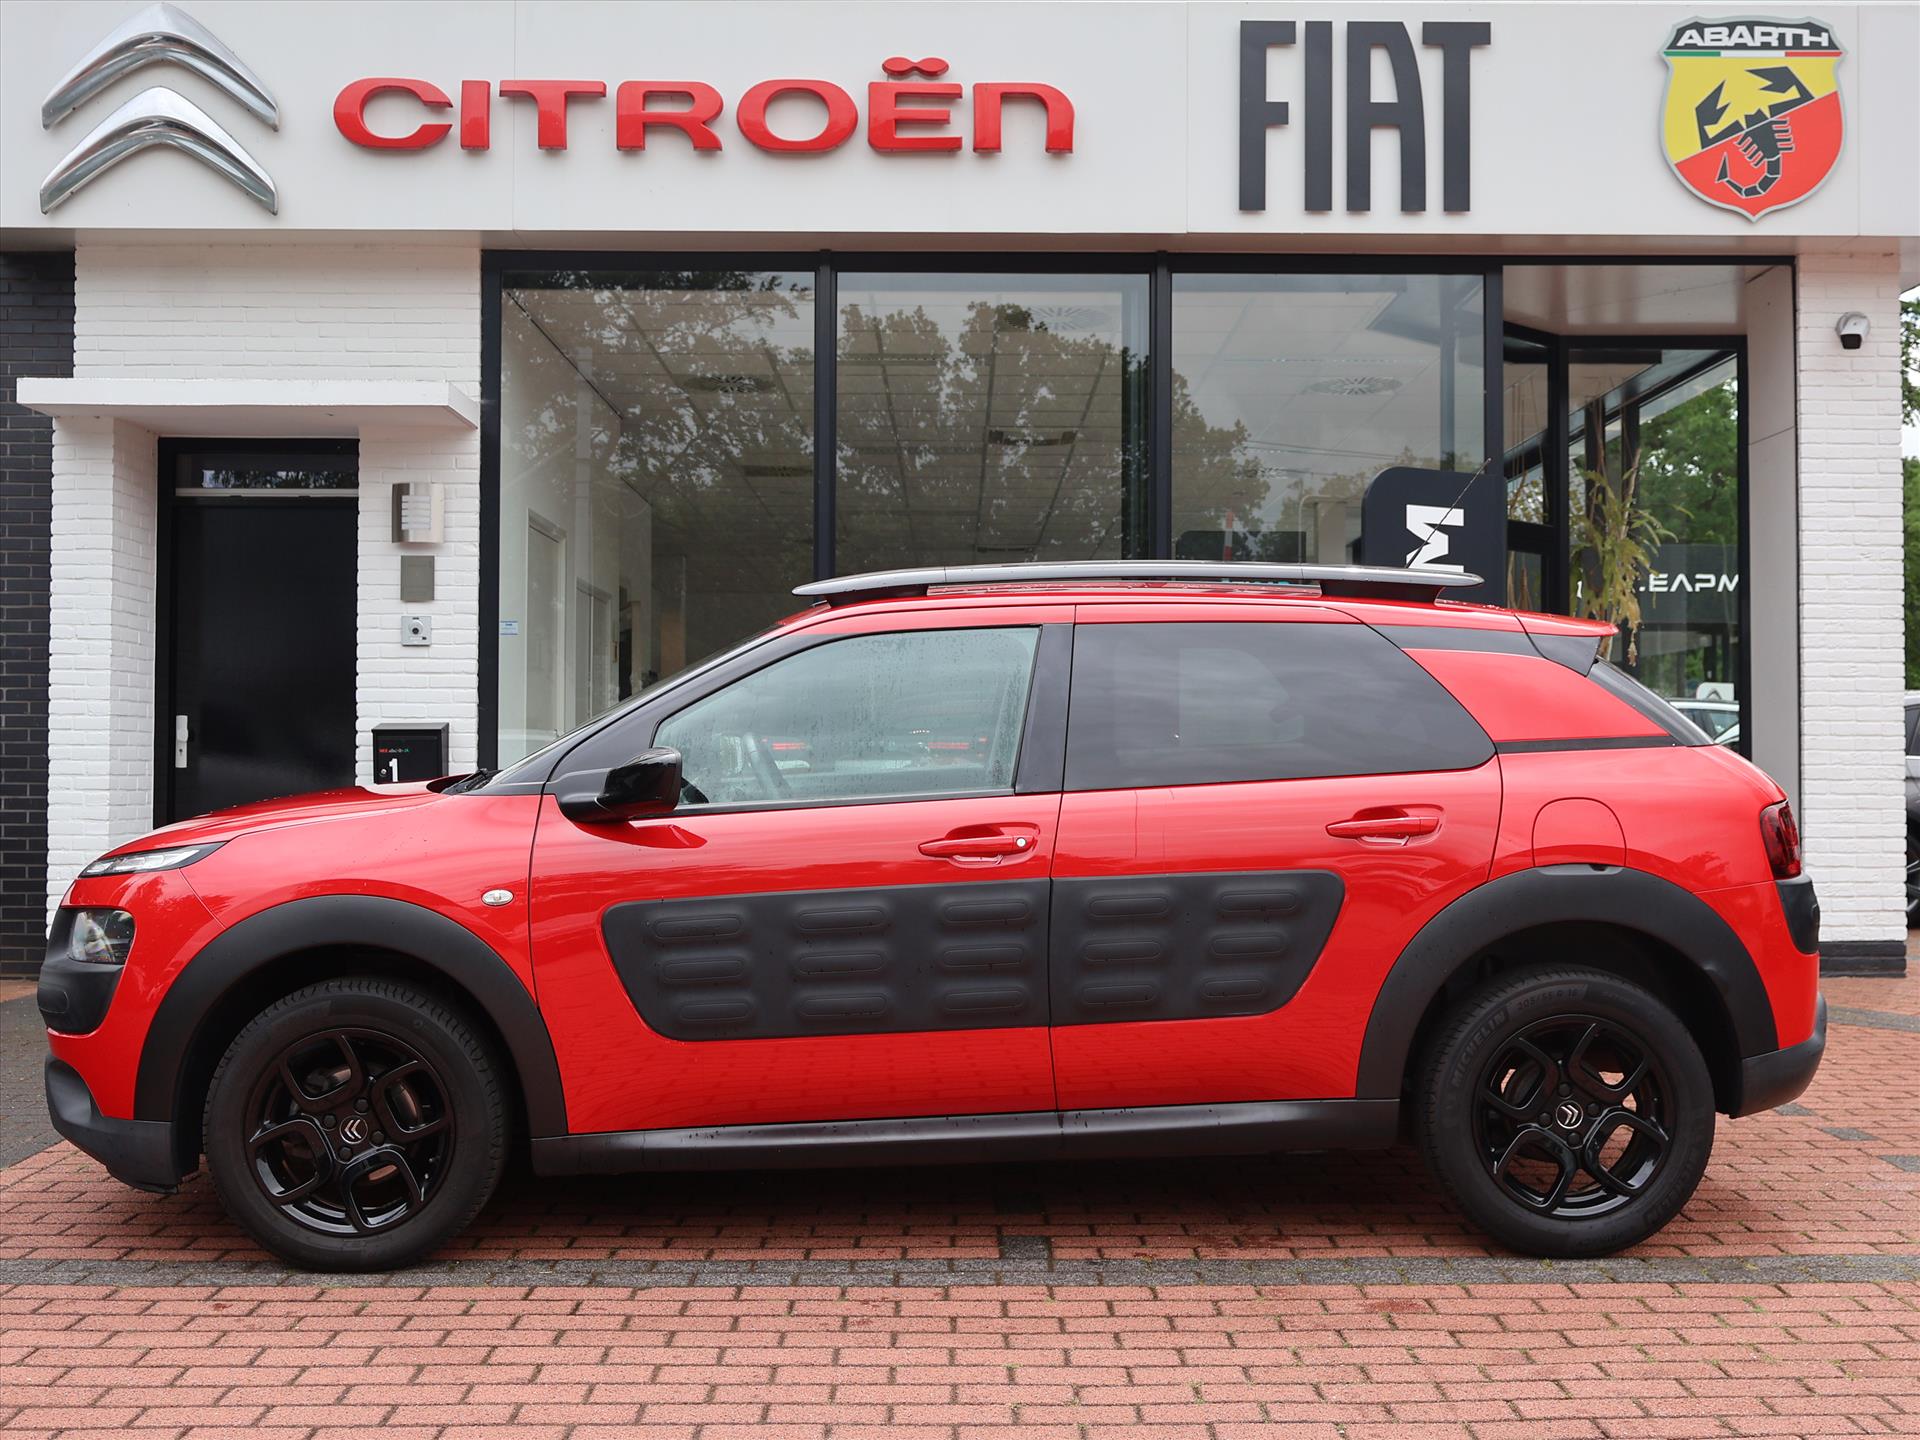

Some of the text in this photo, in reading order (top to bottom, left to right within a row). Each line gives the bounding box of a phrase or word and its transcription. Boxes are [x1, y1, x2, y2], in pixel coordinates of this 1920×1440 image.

[1676, 25, 1829, 47] ABARTH
[1239, 20, 1491, 212] FIAT
[1638, 573, 1739, 592] EAPM
[389, 758, 399, 782] 1
[1451, 1010, 1506, 1088] MICHELIN
